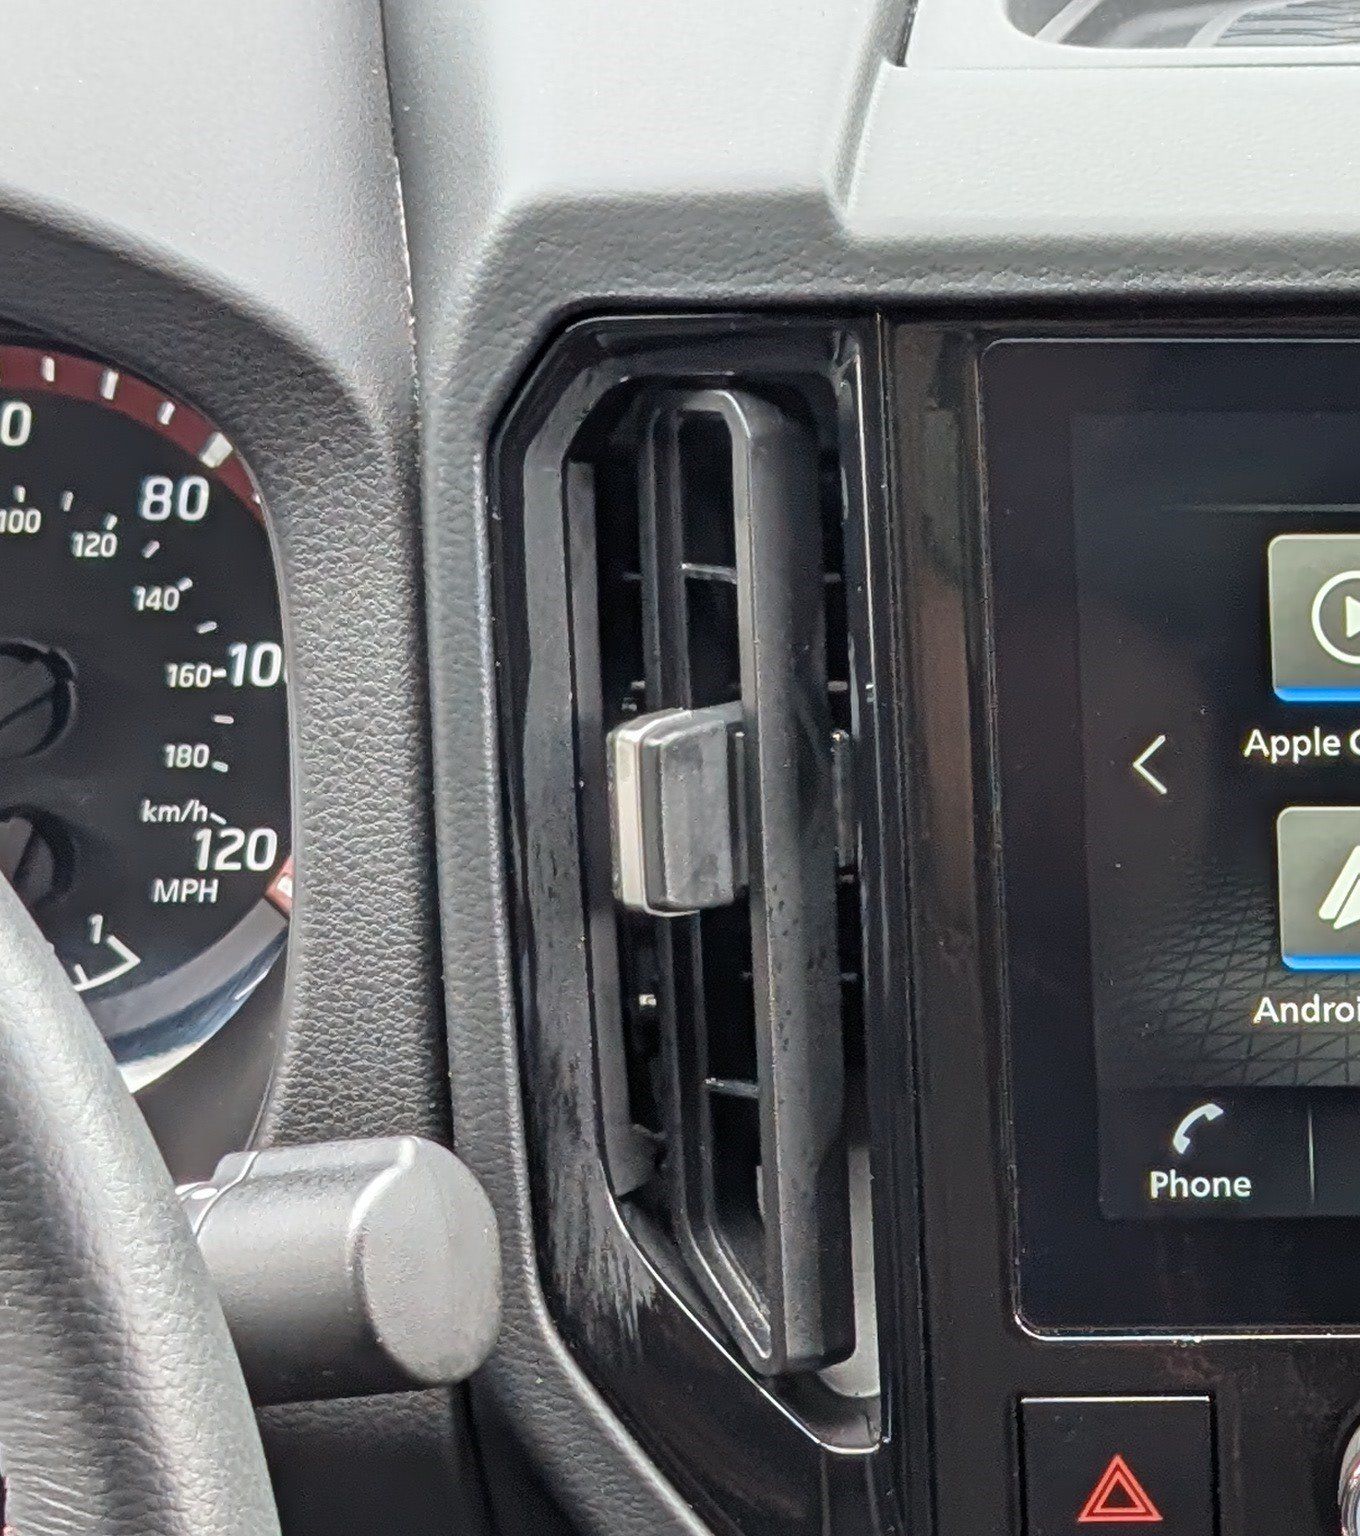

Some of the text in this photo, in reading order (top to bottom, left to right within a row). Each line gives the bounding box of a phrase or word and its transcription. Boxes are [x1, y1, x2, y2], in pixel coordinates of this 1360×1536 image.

[0, 402, 31, 446] 0
[141, 476, 209, 520] 80
[71, 531, 117, 558] 120
[134, 586, 180, 611] 140
[166, 662, 211, 688] 160
[226, 641, 288, 687] 10
[164, 743, 210, 768] 180
[1243, 726, 1341, 765] Apple
[142, 801, 208, 824] km/h
[195, 828, 277, 870] 120
[153, 877, 219, 903] MPH
[1150, 1170, 1253, 1199] Phone
